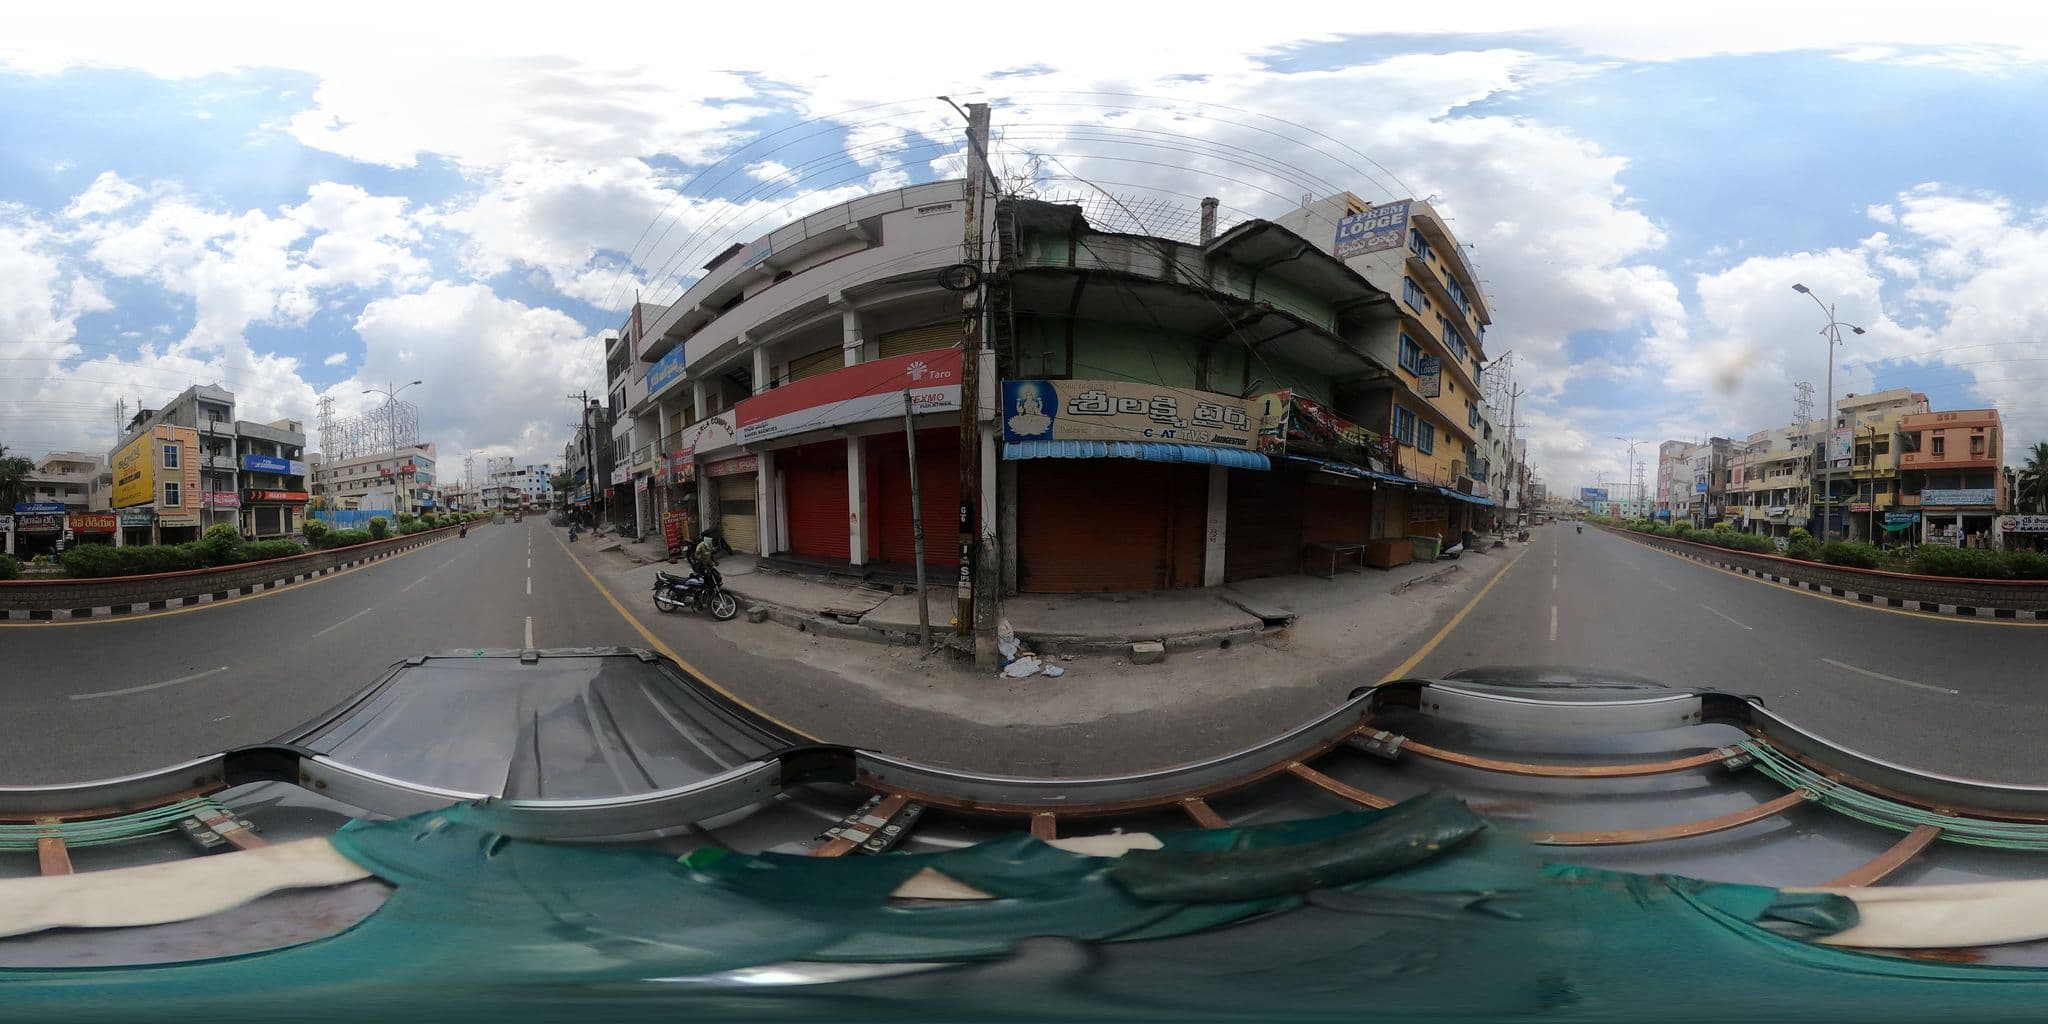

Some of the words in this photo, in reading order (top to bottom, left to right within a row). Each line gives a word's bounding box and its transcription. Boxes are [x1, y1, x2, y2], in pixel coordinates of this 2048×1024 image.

[1340, 213, 1403, 238] LODGE
[929, 370, 951, 379] Taro
[1144, 428, 1177, 439] CAT
